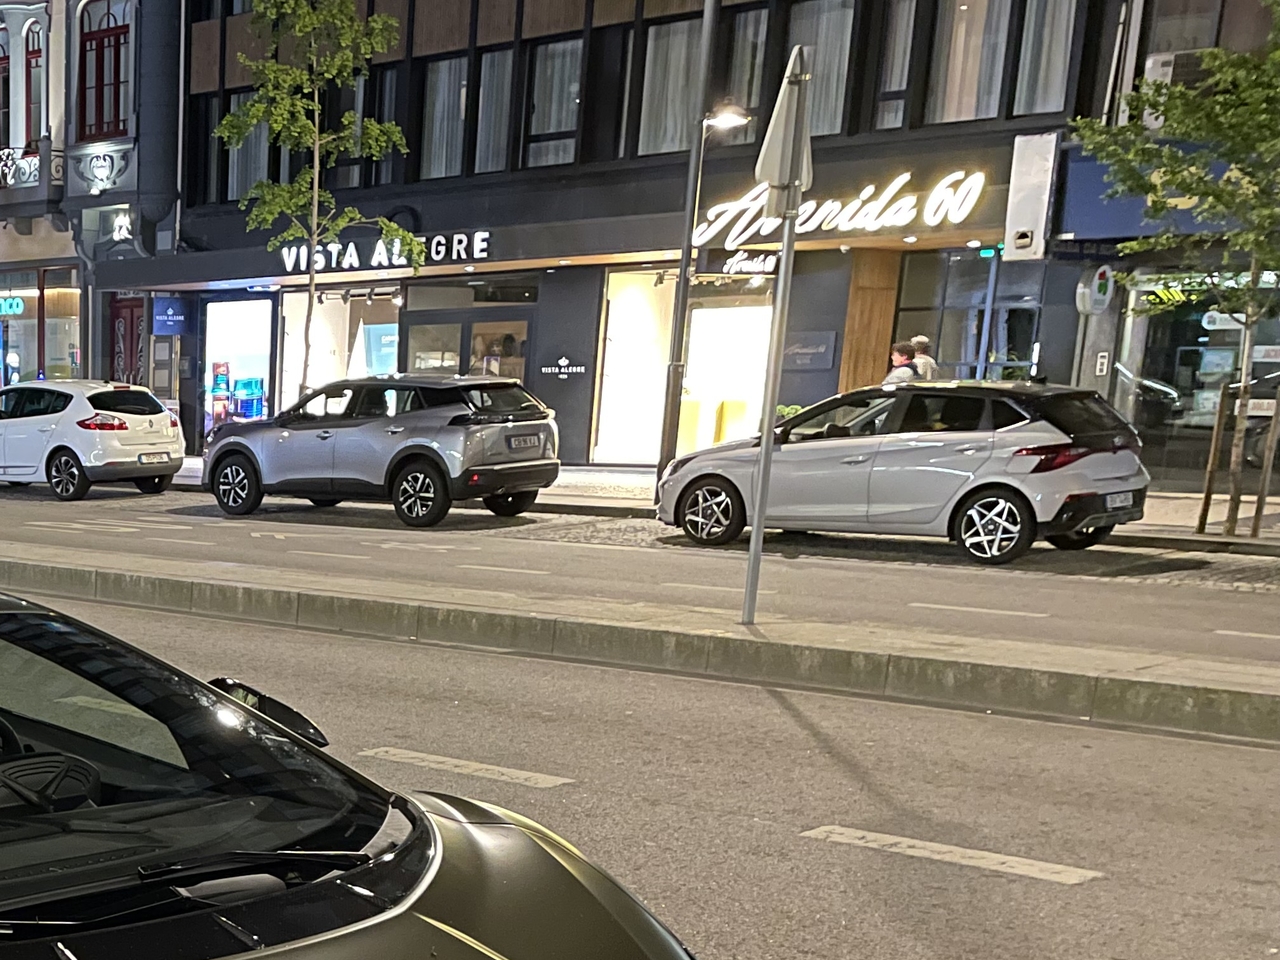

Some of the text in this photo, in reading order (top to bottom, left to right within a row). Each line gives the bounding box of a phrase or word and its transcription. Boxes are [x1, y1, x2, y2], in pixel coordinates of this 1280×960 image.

[923, 170, 986, 227] 60
[281, 231, 490, 273] VISTA ALGRE
